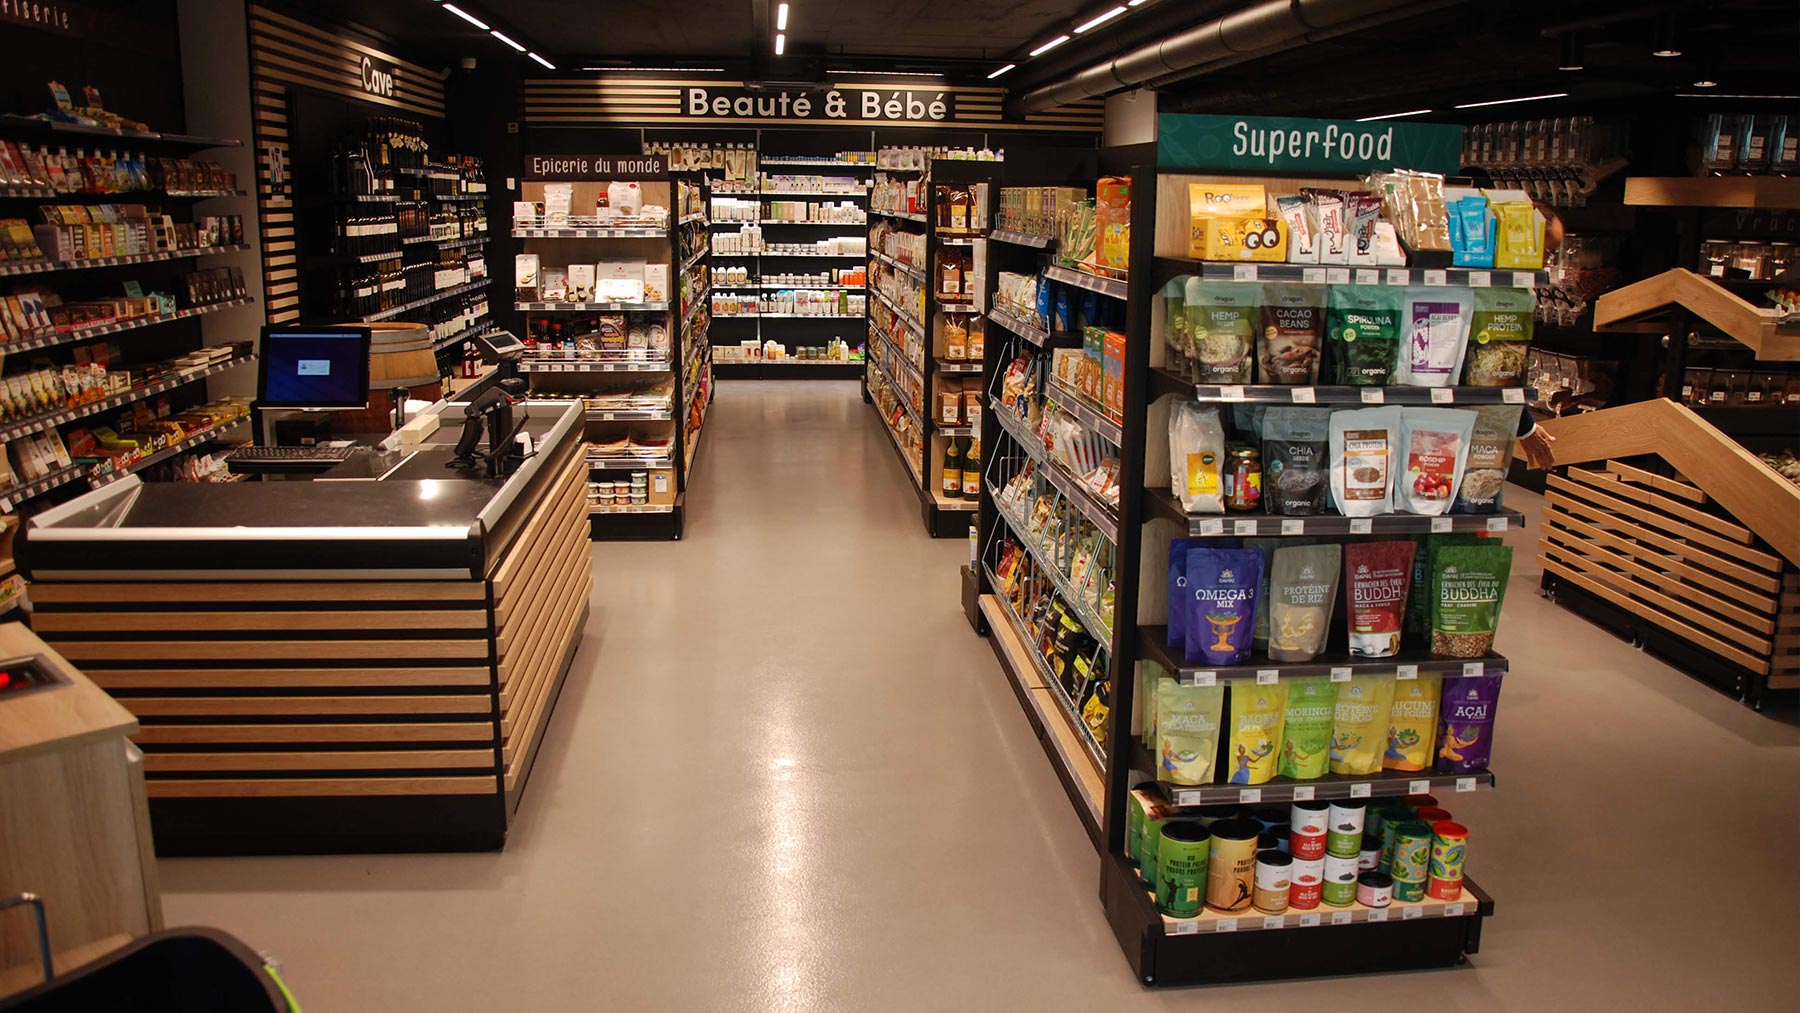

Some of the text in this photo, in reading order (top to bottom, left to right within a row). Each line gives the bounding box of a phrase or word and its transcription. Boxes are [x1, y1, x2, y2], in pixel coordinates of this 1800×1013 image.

[363, 56, 393, 97] Cave
[688, 88, 947, 120] Beauté & Bébé
[1233, 121, 1393, 164] Superfood
[534, 158, 660, 176] Epicerie du monde
[1212, 312, 1240, 320] HEMP
[1276, 309, 1312, 319] CACAO
[1280, 320, 1310, 329] BEANS
[1348, 315, 1392, 325] SPIRULINA
[1488, 323, 1522, 331] PROTEIN
[1212, 366, 1239, 374] organic
[1362, 368, 1386, 376] organic
[1289, 446, 1313, 455] CHIA
[1471, 445, 1498, 454] MACA
[1285, 500, 1311, 508] organic
[1248, 588, 1254, 599] 3
[1284, 584, 1330, 595] PROTÉINE
[1354, 586, 1400, 600] BUDDH
[1441, 588, 1498, 600] BUDDHA
[1291, 594, 1323, 604] DE RIZ
[1172, 714, 1206, 724] MACA
